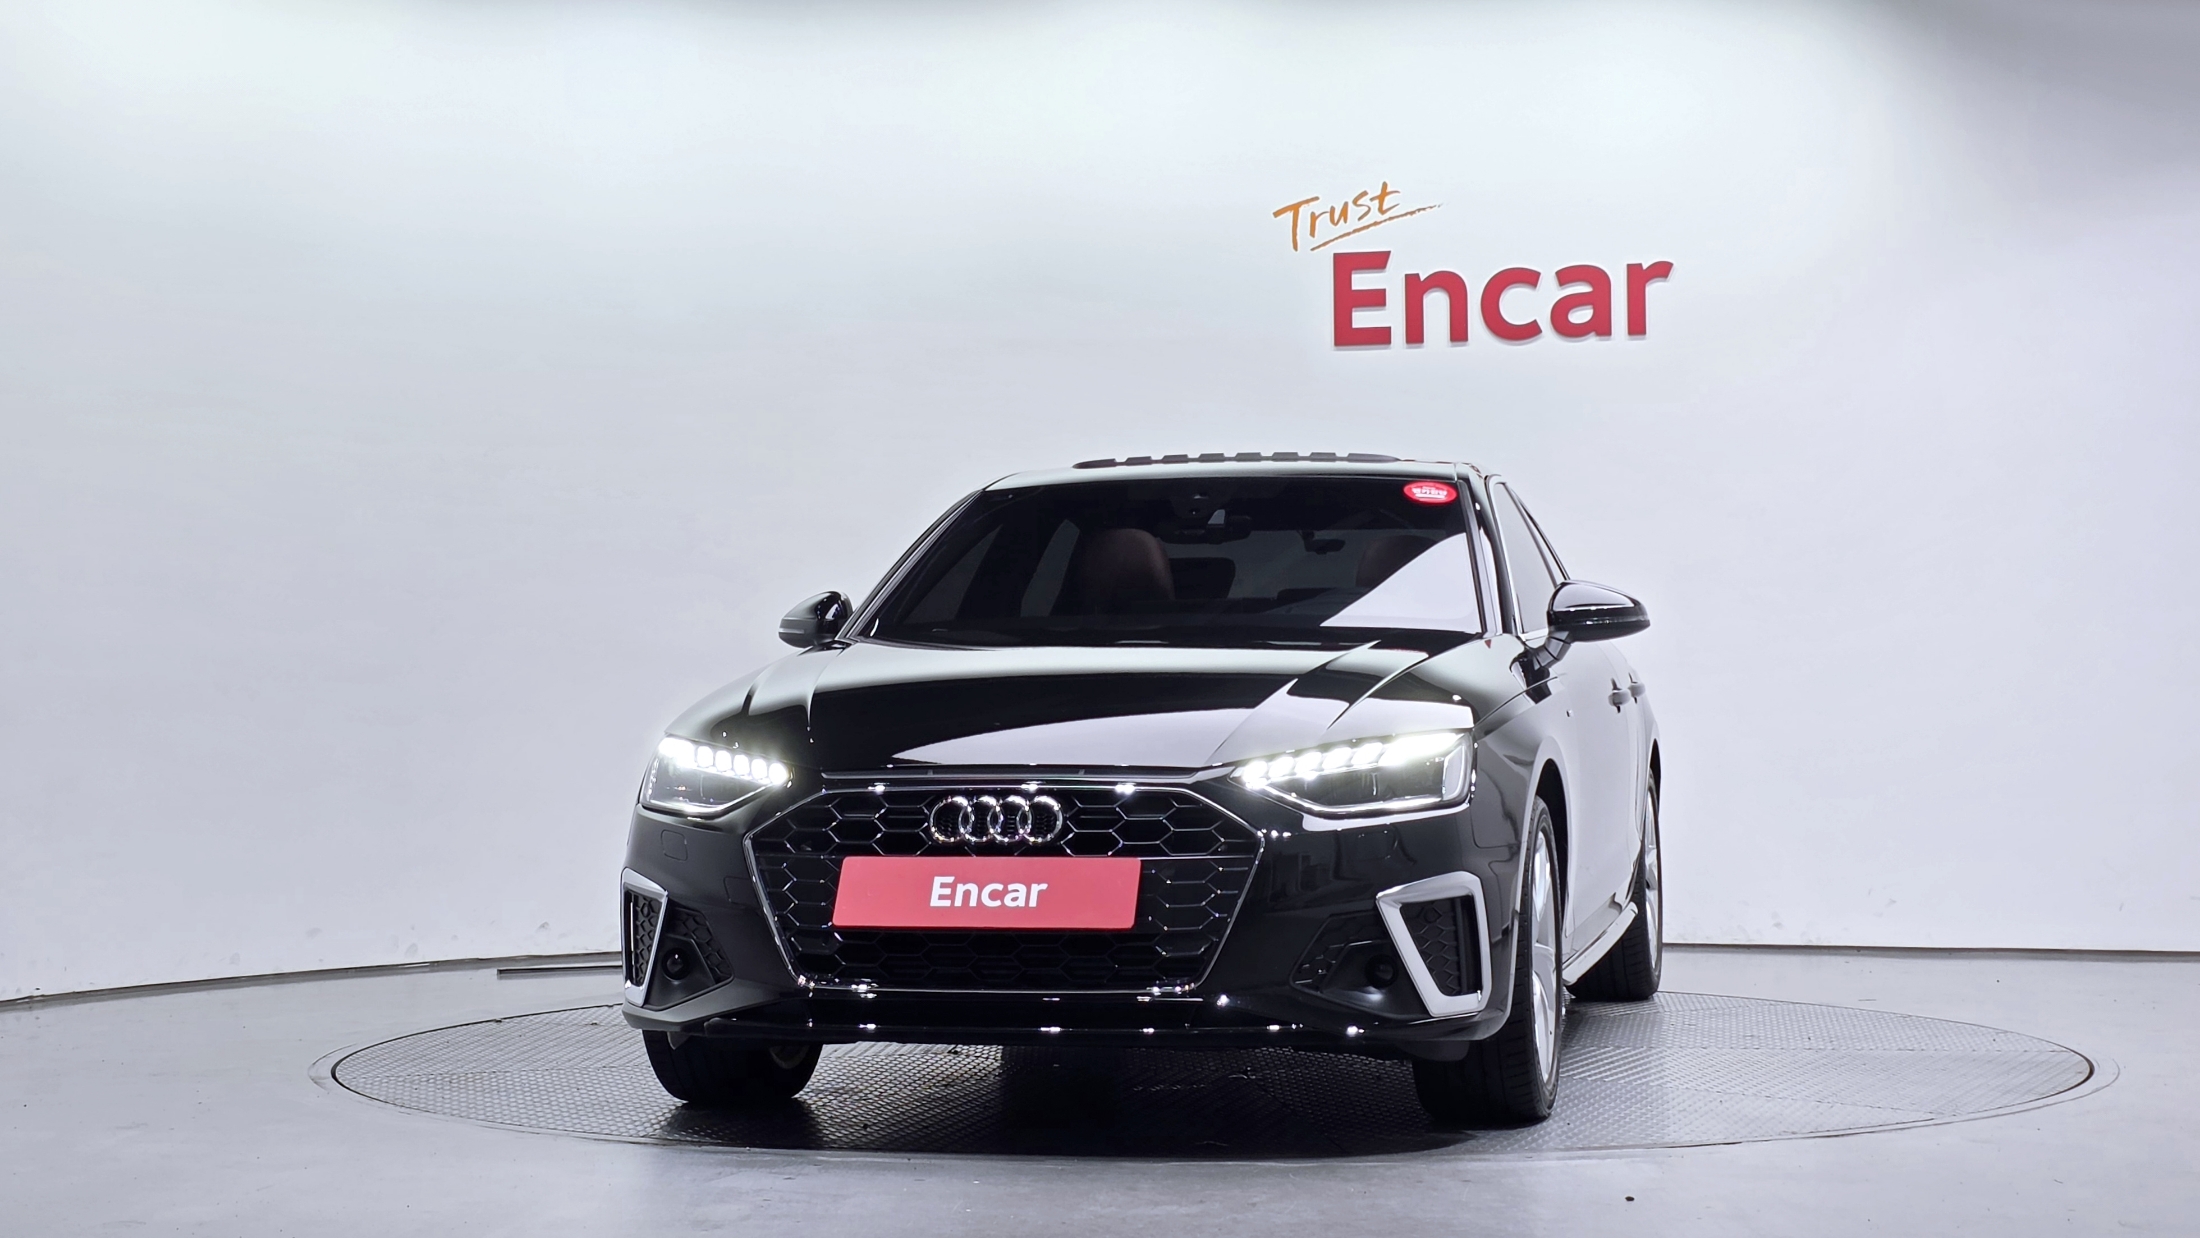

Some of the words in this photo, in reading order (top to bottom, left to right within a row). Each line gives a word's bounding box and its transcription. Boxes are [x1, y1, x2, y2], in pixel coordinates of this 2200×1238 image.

[1273, 181, 1400, 251] Trust
[1333, 250, 1674, 346] Encar
[929, 876, 1048, 907] Encar
